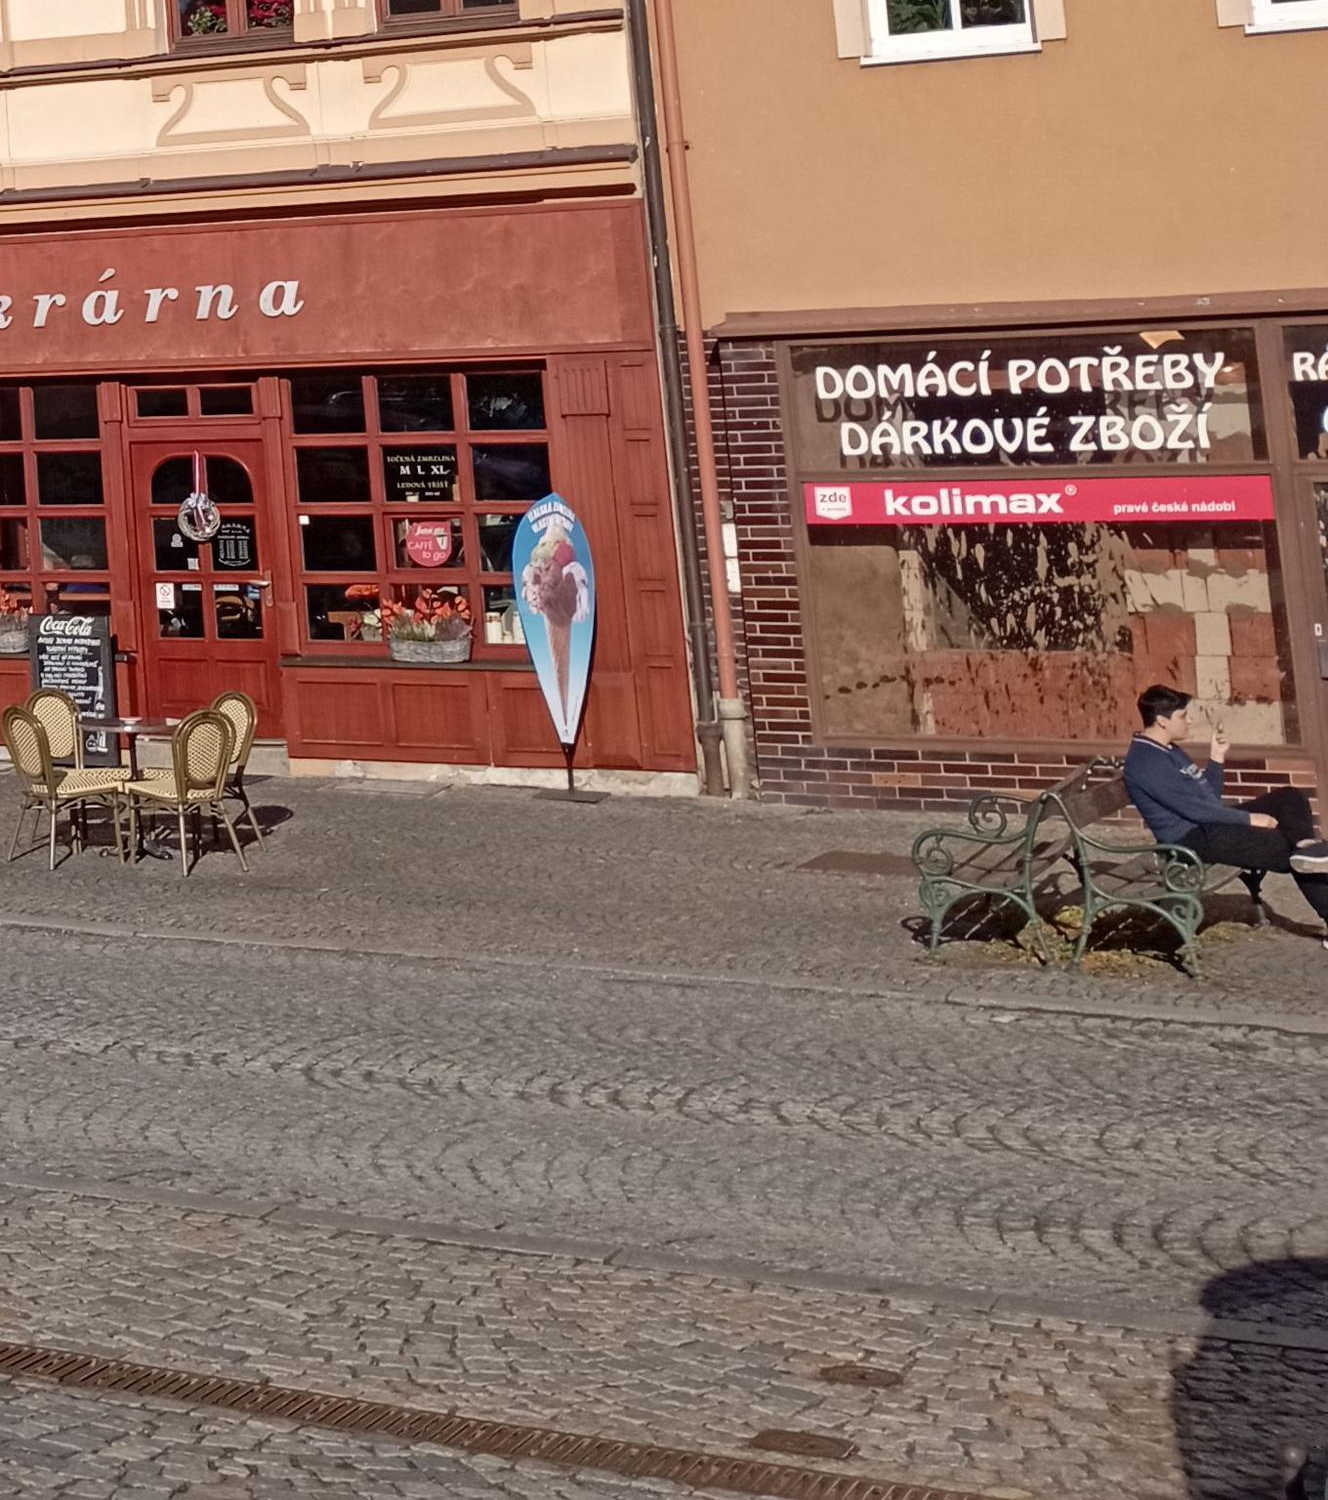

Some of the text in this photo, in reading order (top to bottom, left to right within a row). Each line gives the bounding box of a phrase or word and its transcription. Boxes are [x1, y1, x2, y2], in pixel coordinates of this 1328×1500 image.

[815, 346, 1225, 400] DOMÁCÍ POTŘEBY
[840, 402, 1212, 456] DÁRKOVÉ ZBOŽÍ
[399, 465, 451, 475] M L XL
[819, 491, 847, 503] zde
[1113, 500, 1236, 516] pravé české nádobí
